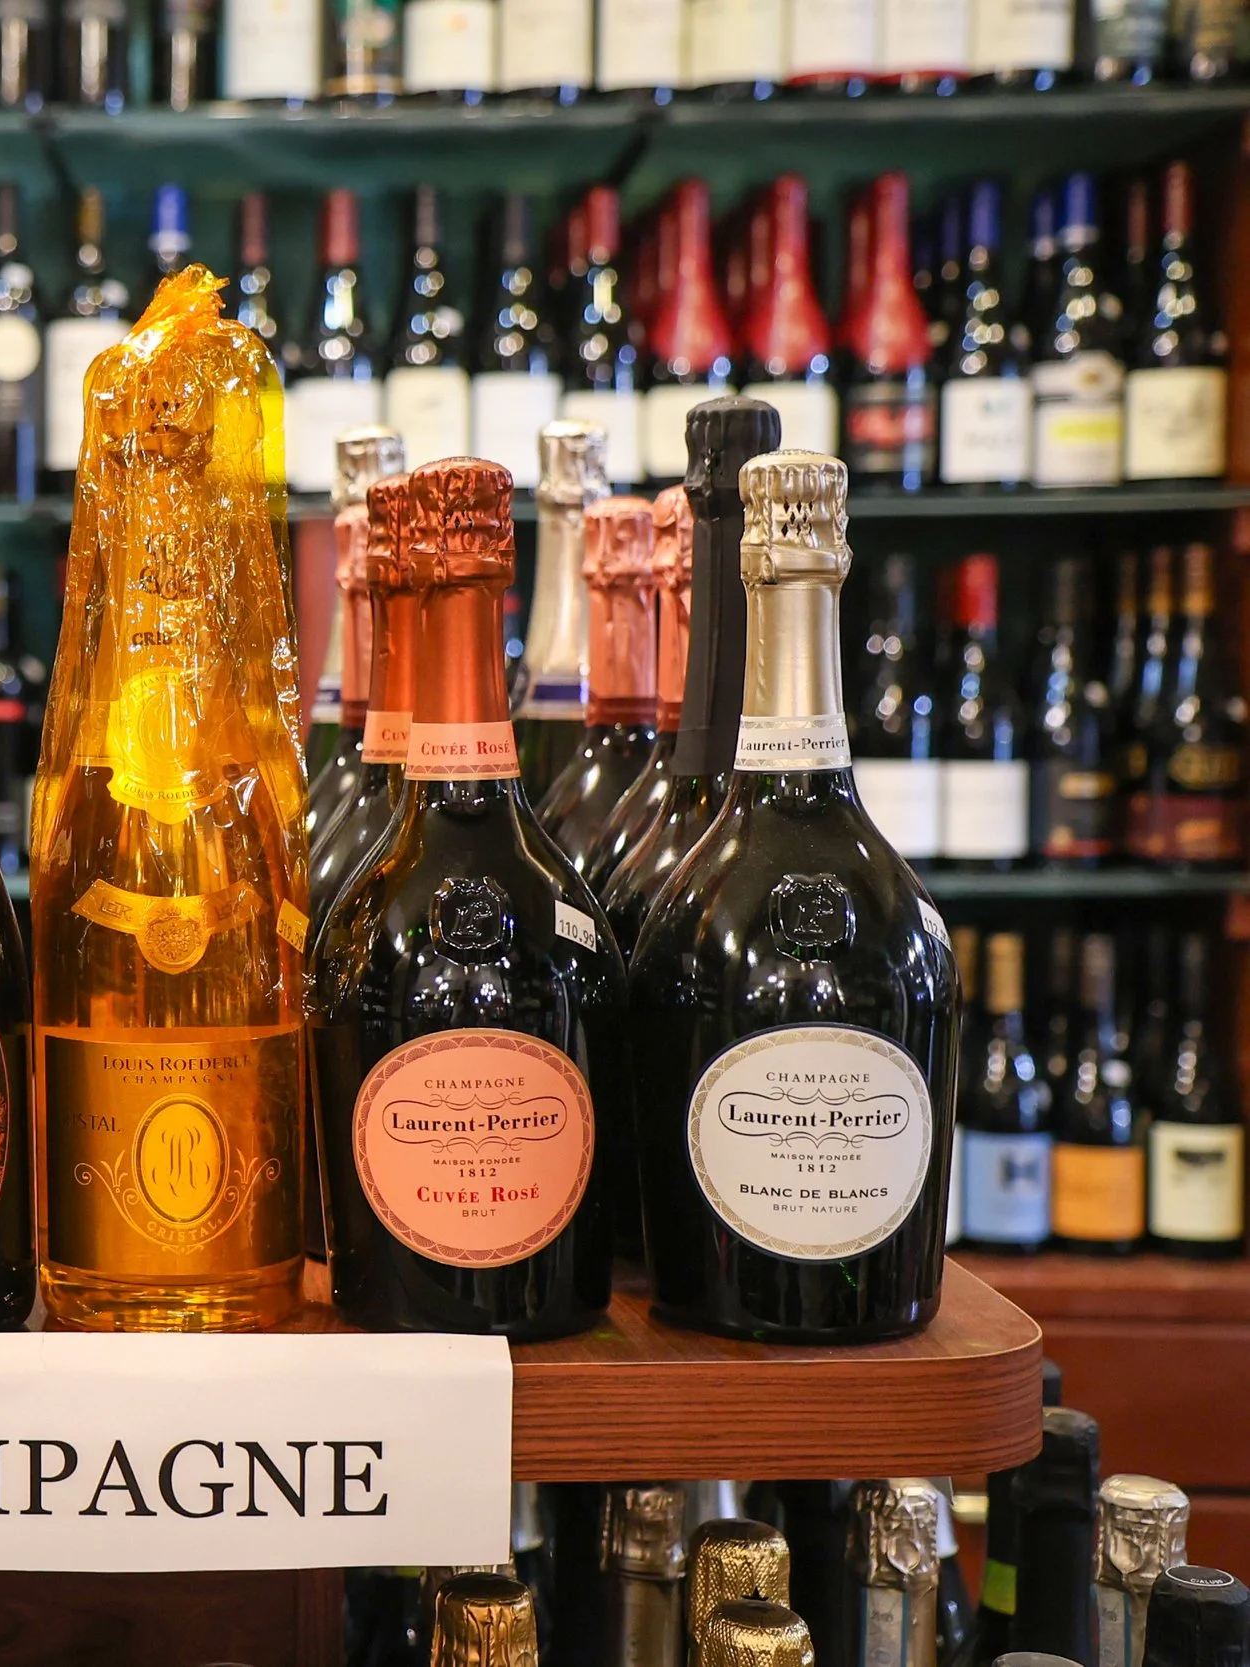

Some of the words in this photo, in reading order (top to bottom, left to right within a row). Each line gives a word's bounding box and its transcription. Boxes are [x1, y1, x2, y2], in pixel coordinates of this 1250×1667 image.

[421, 741, 467, 756] CUVÉE
[477, 739, 510, 755] ROSÉ
[740, 737, 846, 752] Laurent-Perrier
[559, 919, 595, 948] 110.99
[103, 1055, 154, 1072] LOUIS
[424, 1077, 526, 1090] CHAMPAGNE
[766, 1071, 871, 1084] CHAMPAGNE
[391, 1111, 559, 1133] Laurent-Perrier
[728, 1104, 902, 1128] Laurent-Perrier
[479, 1156, 522, 1165] FONDÉE
[770, 1152, 814, 1161] MAISON
[459, 1168, 497, 1178] 1812
[797, 1163, 837, 1174] 1812
[417, 1186, 480, 1204] CUVÉE
[491, 1183, 540, 1203] ROSÉ
[739, 1184, 793, 1198] BLANC
[800, 1189, 821, 1199] DE
[829, 1187, 889, 1200] BLANCS
[462, 1208, 497, 1218] BRUT
[773, 1203, 804, 1213] BRUT
[812, 1205, 858, 1214] NATURE
